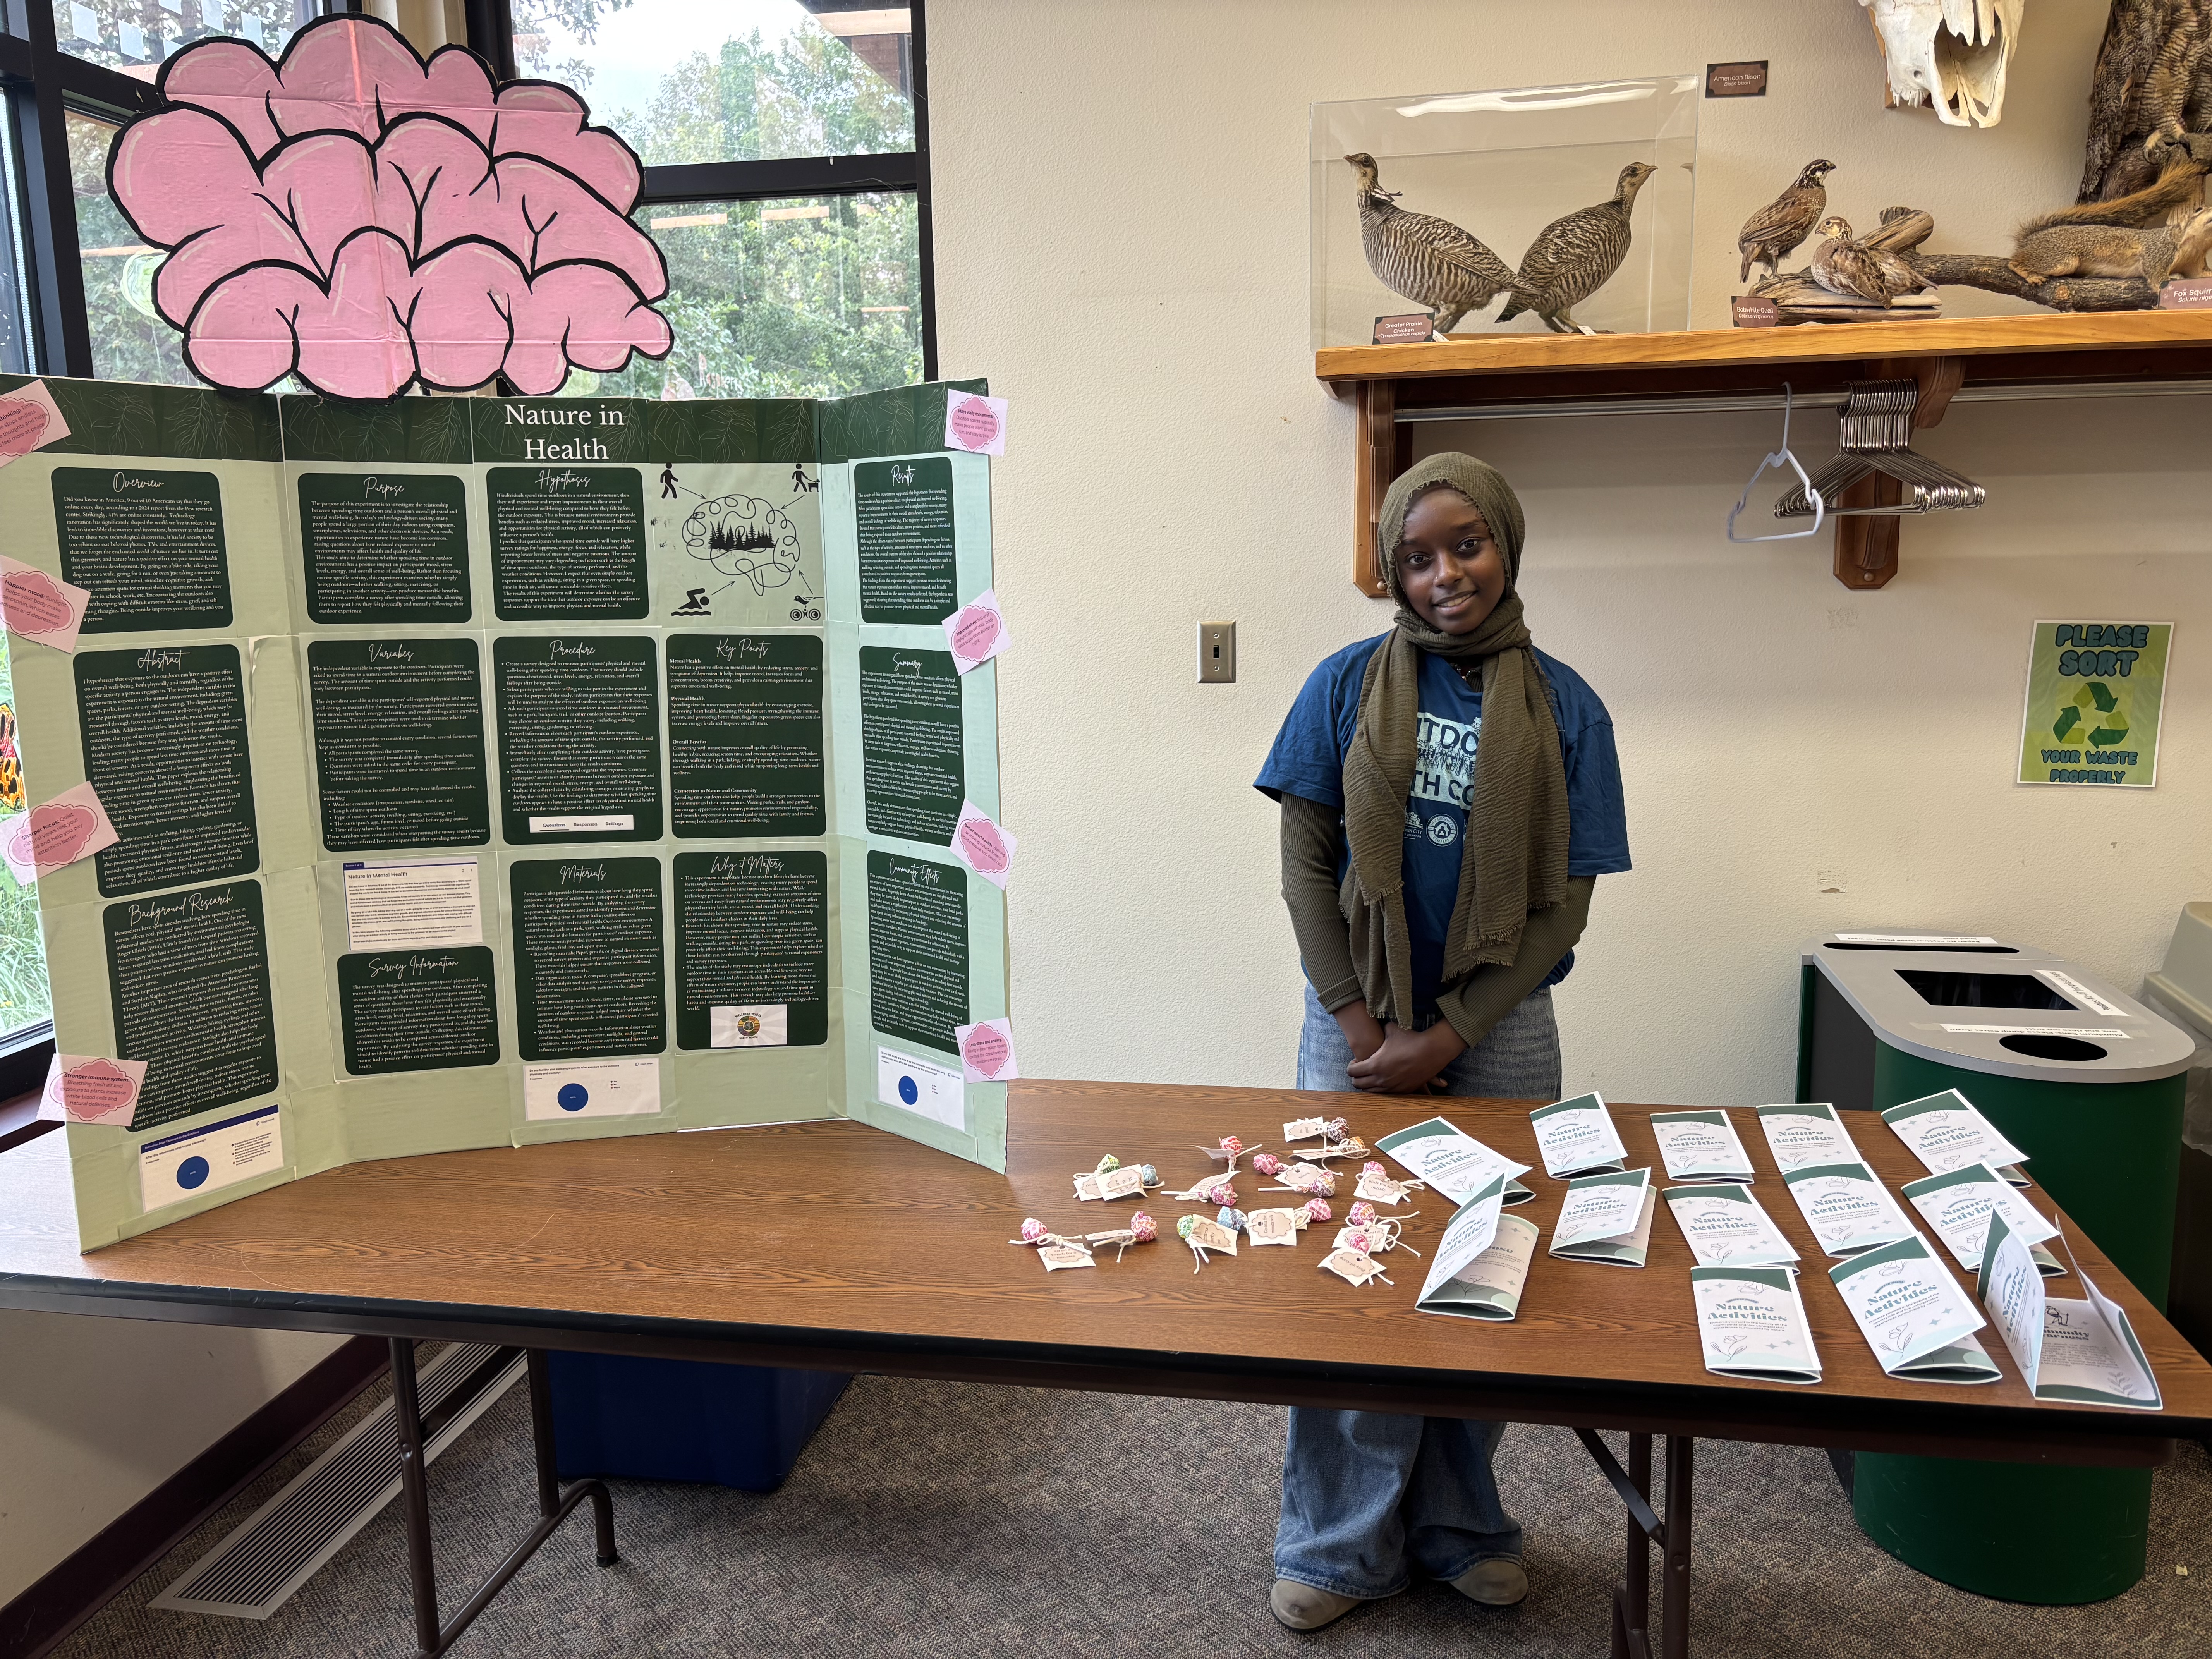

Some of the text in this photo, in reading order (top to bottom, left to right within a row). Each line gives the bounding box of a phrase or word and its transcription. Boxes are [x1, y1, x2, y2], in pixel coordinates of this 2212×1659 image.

[2189, 288, 2212, 296] Squirr
[21, 402, 34, 411] Time
[504, 404, 625, 425] Nature in
[524, 438, 609, 459] Health
[113, 471, 164, 493] Overview
[364, 477, 405, 500] Purpose
[5, 579, 67, 608] Happier mood: Sunlight
[2055, 624, 2149, 648] PLEASE
[550, 640, 596, 660] Procedure
[715, 638, 772, 661] Key Points
[137, 649, 191, 672] Abstract
[893, 652, 922, 675] Summary
[2058, 650, 2139, 677] SORT
[2041, 749, 2138, 766] YOUR WASTE
[2049, 769, 2126, 784] PROPERLY
[21, 812, 74, 841] Sharper focus: Quiet
[560, 864, 607, 884] Materials
[711, 855, 737, 879] Why
[747, 855, 785, 875] Matters
[889, 857, 942, 886] Community Effects
[128, 888, 234, 927] Background Research
[368, 955, 459, 979] Survey Information
[1543, 1128, 1601, 1146] Activities
[1548, 1124, 1590, 1138] Nature
[1773, 1136, 1835, 1144] Activities
[1918, 1130, 1980, 1150] Activities
[1919, 1126, 1966, 1142] Nature
[1421, 1149, 1463, 1166] Nature
[1423, 1152, 1477, 1175] Activities
[1563, 1203, 1627, 1217] Activities
[1573, 1199, 1621, 1209] Nature
[1810, 1201, 1879, 1216] Activities
[1813, 1195, 1865, 1207] Nature
[1941, 1198, 1992, 1217] Nature
[1689, 1222, 1757, 1232] Activities
[1865, 1285, 1937, 1319] Activities
[1867, 1281, 1922, 1306] Nature
[1707, 1312, 1787, 1322] Activities
[1716, 1304, 1774, 1312] Nature
[1886, 1307, 1901, 1316] yourself
